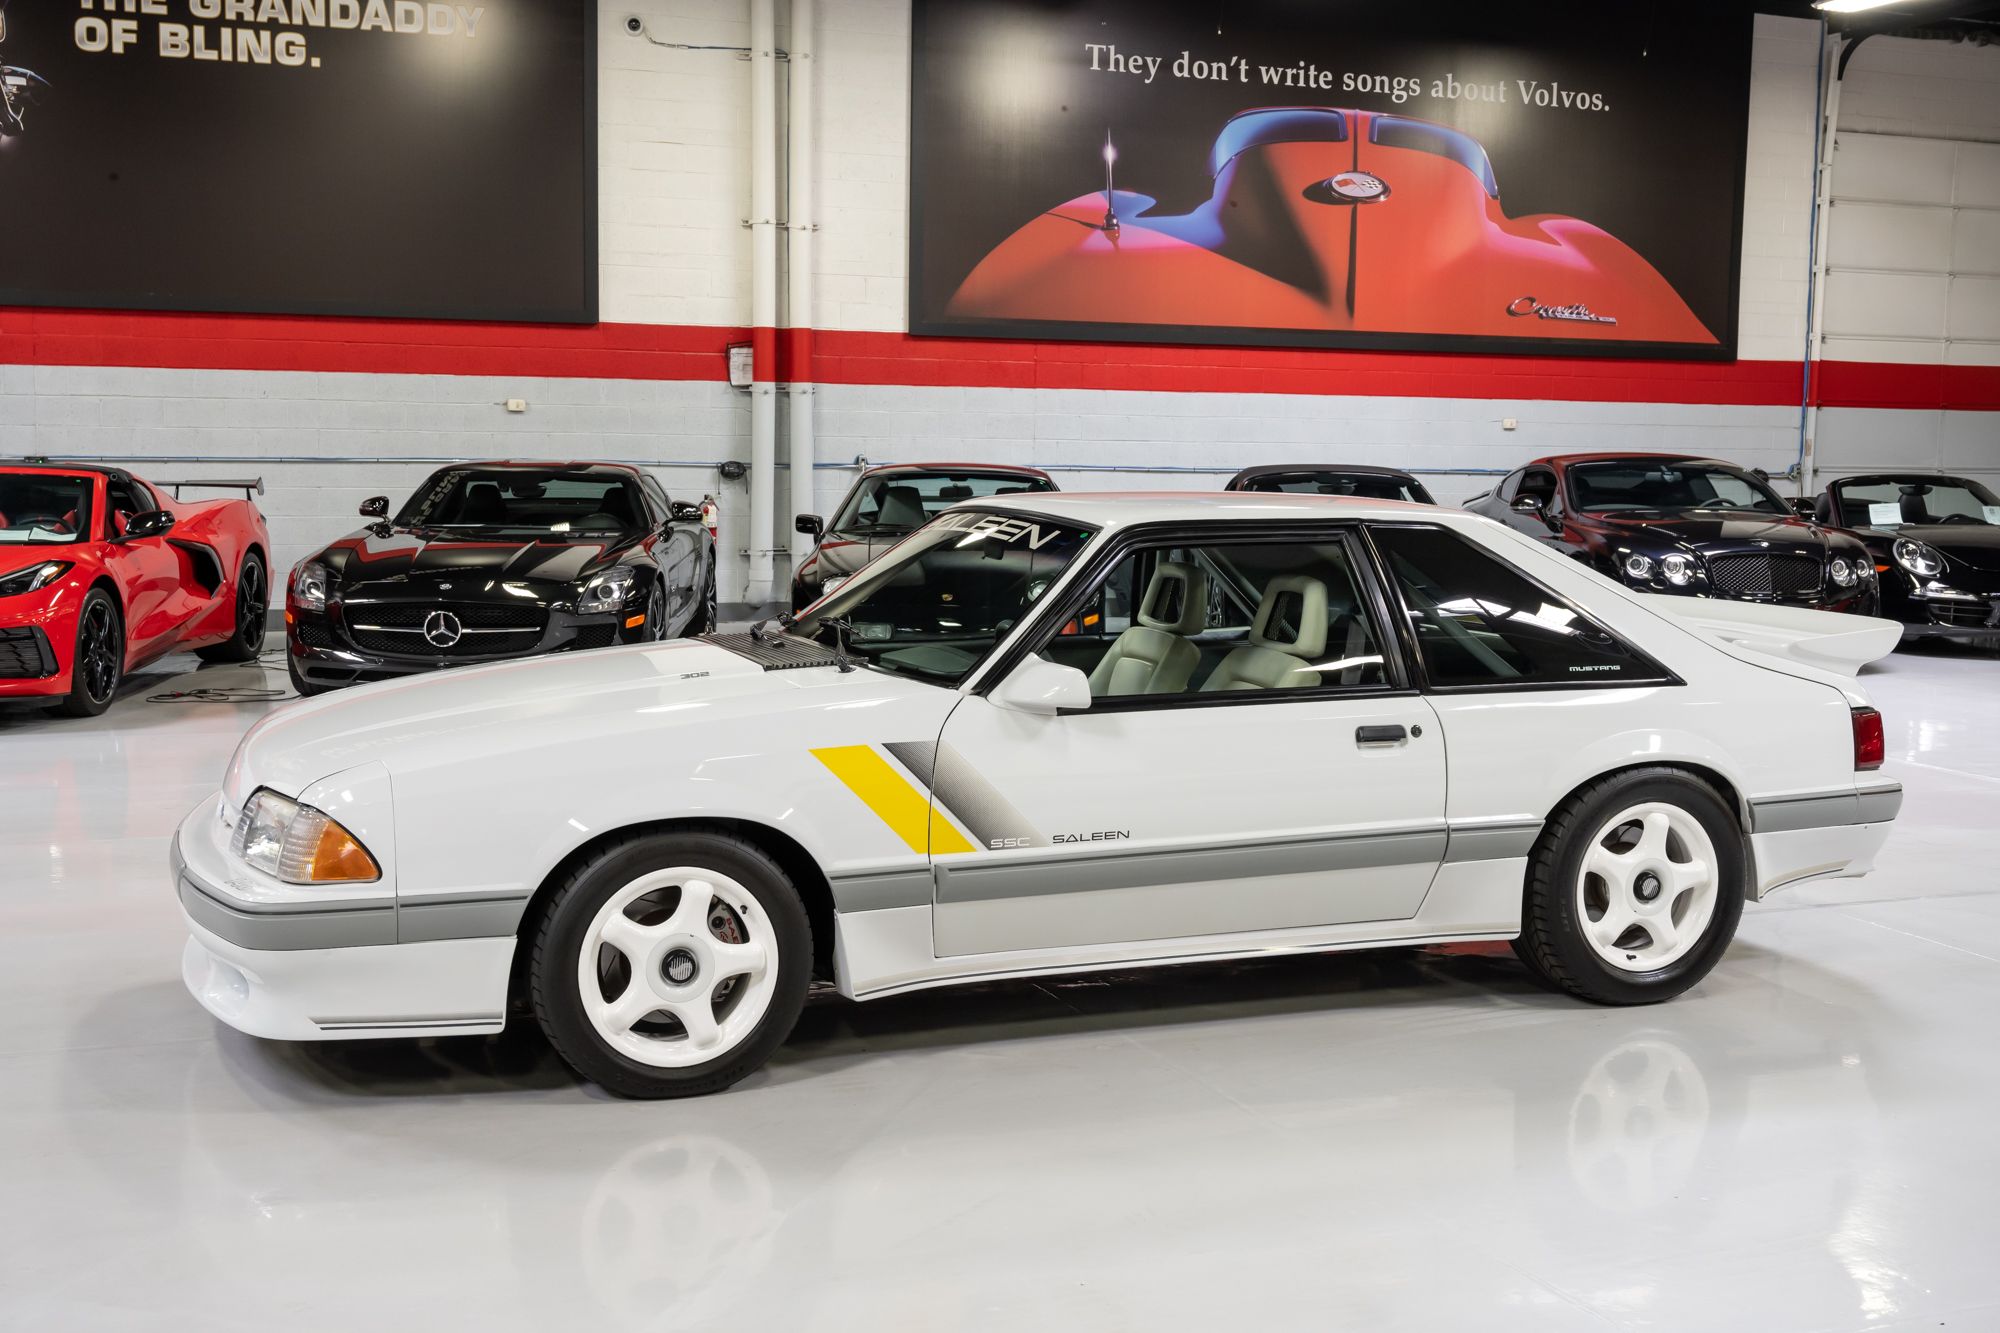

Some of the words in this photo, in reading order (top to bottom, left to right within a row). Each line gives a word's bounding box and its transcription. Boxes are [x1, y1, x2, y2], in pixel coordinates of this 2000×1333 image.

[189, 0, 484, 37] GRANDADDY
[74, 16, 138, 54] OF
[158, 22, 321, 67] BLING.
[1085, 43, 1162, 84] They
[1172, 50, 1249, 83] don't
[1259, 60, 1333, 90] write
[1342, 72, 1421, 104] songs
[1430, 73, 1508, 104] about
[1516, 79, 1610, 111] Volvos.
[929, 511, 1062, 551] ALEEN
[679, 671, 711, 680] 302
[1569, 664, 1621, 672] MUSTANG
[990, 837, 1031, 849] SSC
[1052, 830, 1130, 844] SALEEN
